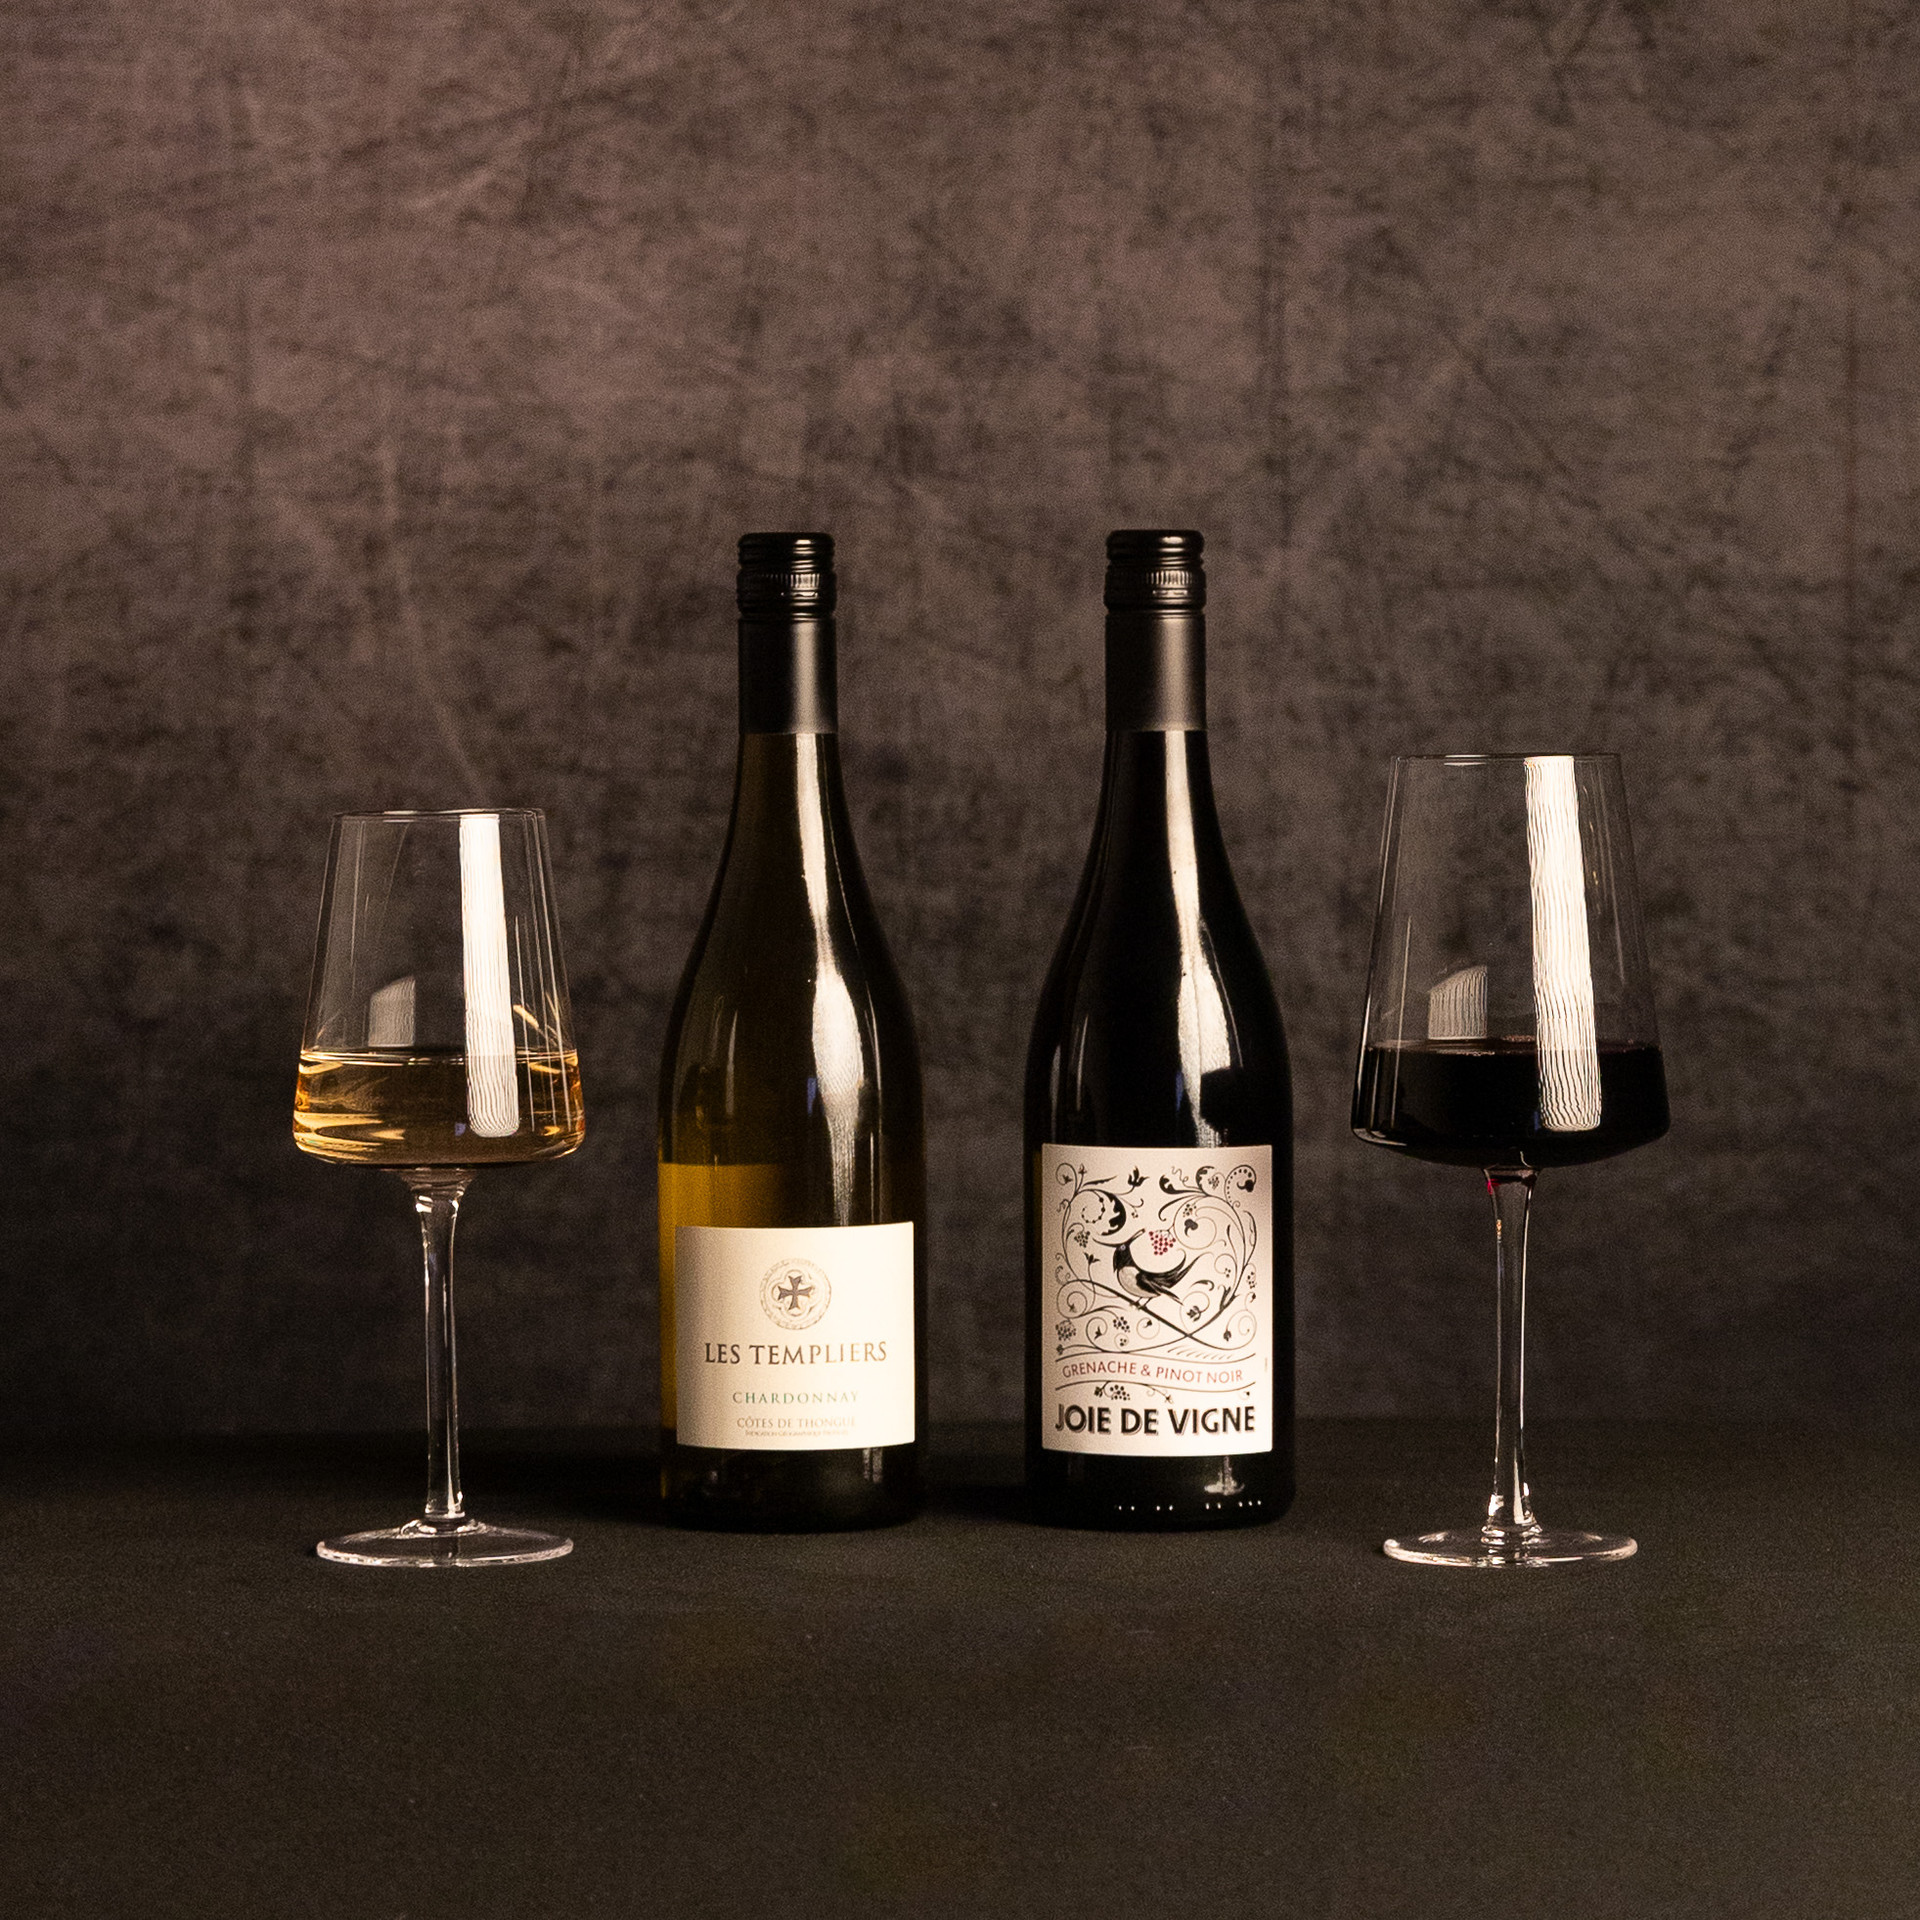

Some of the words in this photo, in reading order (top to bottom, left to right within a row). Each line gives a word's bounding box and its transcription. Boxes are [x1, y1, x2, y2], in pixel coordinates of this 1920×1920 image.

[704, 1342, 741, 1365] LES
[749, 1341, 887, 1365] TEMPLIERS
[1062, 1361, 1137, 1379] GRENACHE
[1140, 1366, 1151, 1377] &
[1155, 1366, 1203, 1384] PINOT
[1206, 1369, 1243, 1384] NOIR
[732, 1391, 859, 1405] CHARDONNAY
[736, 1415, 774, 1429] CÔTES
[777, 1418, 792, 1428] DE
[1055, 1403, 1112, 1436] JOIE
[1120, 1408, 1159, 1435] DE
[1168, 1405, 1255, 1435] VIGNE
